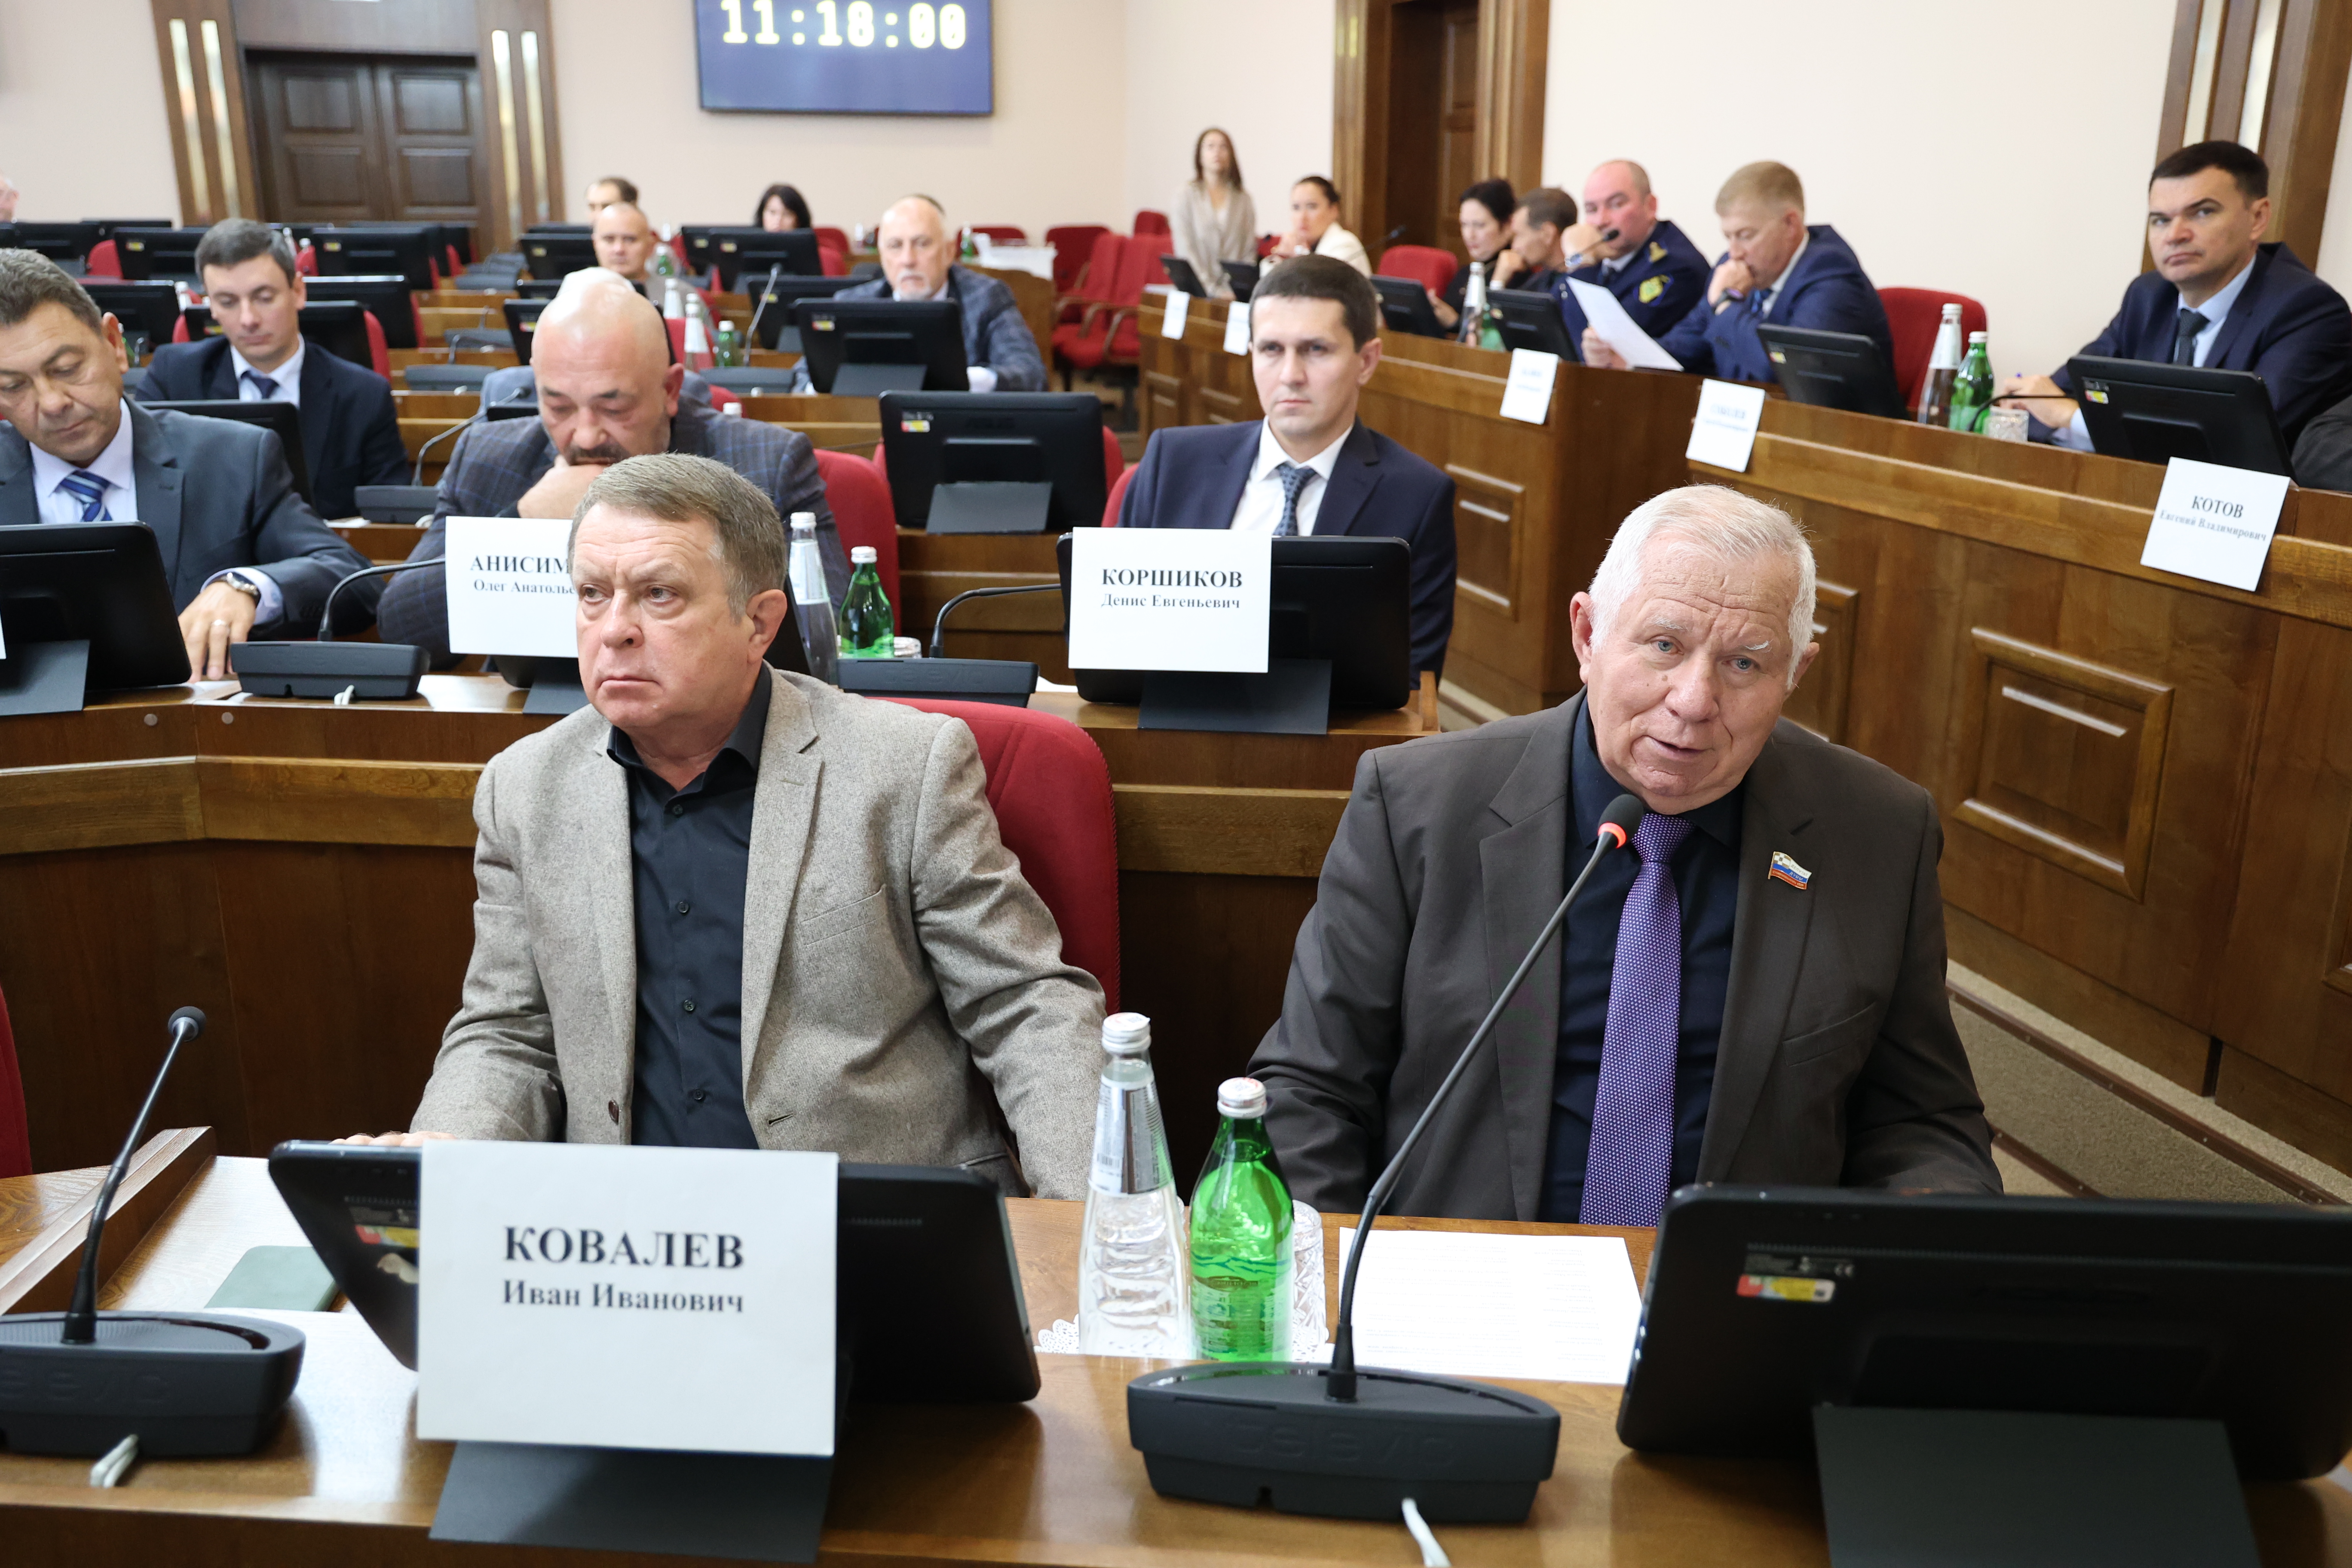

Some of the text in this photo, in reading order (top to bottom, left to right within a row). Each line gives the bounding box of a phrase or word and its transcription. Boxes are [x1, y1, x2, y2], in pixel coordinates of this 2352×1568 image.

[720, 0, 966, 49] 11:18:00
[2191, 496, 2244, 518] КОТОВ
[2159, 510, 2266, 542] Евгений Владимирович
[474, 579, 506, 592] Олег
[1101, 568, 1242, 588] КОРШИКОВ
[1101, 594, 1240, 608] Денис Евгеньевич
[503, 1225, 745, 1270] КОВАЛЕВ
[503, 1279, 744, 1314] Иван Иванович
